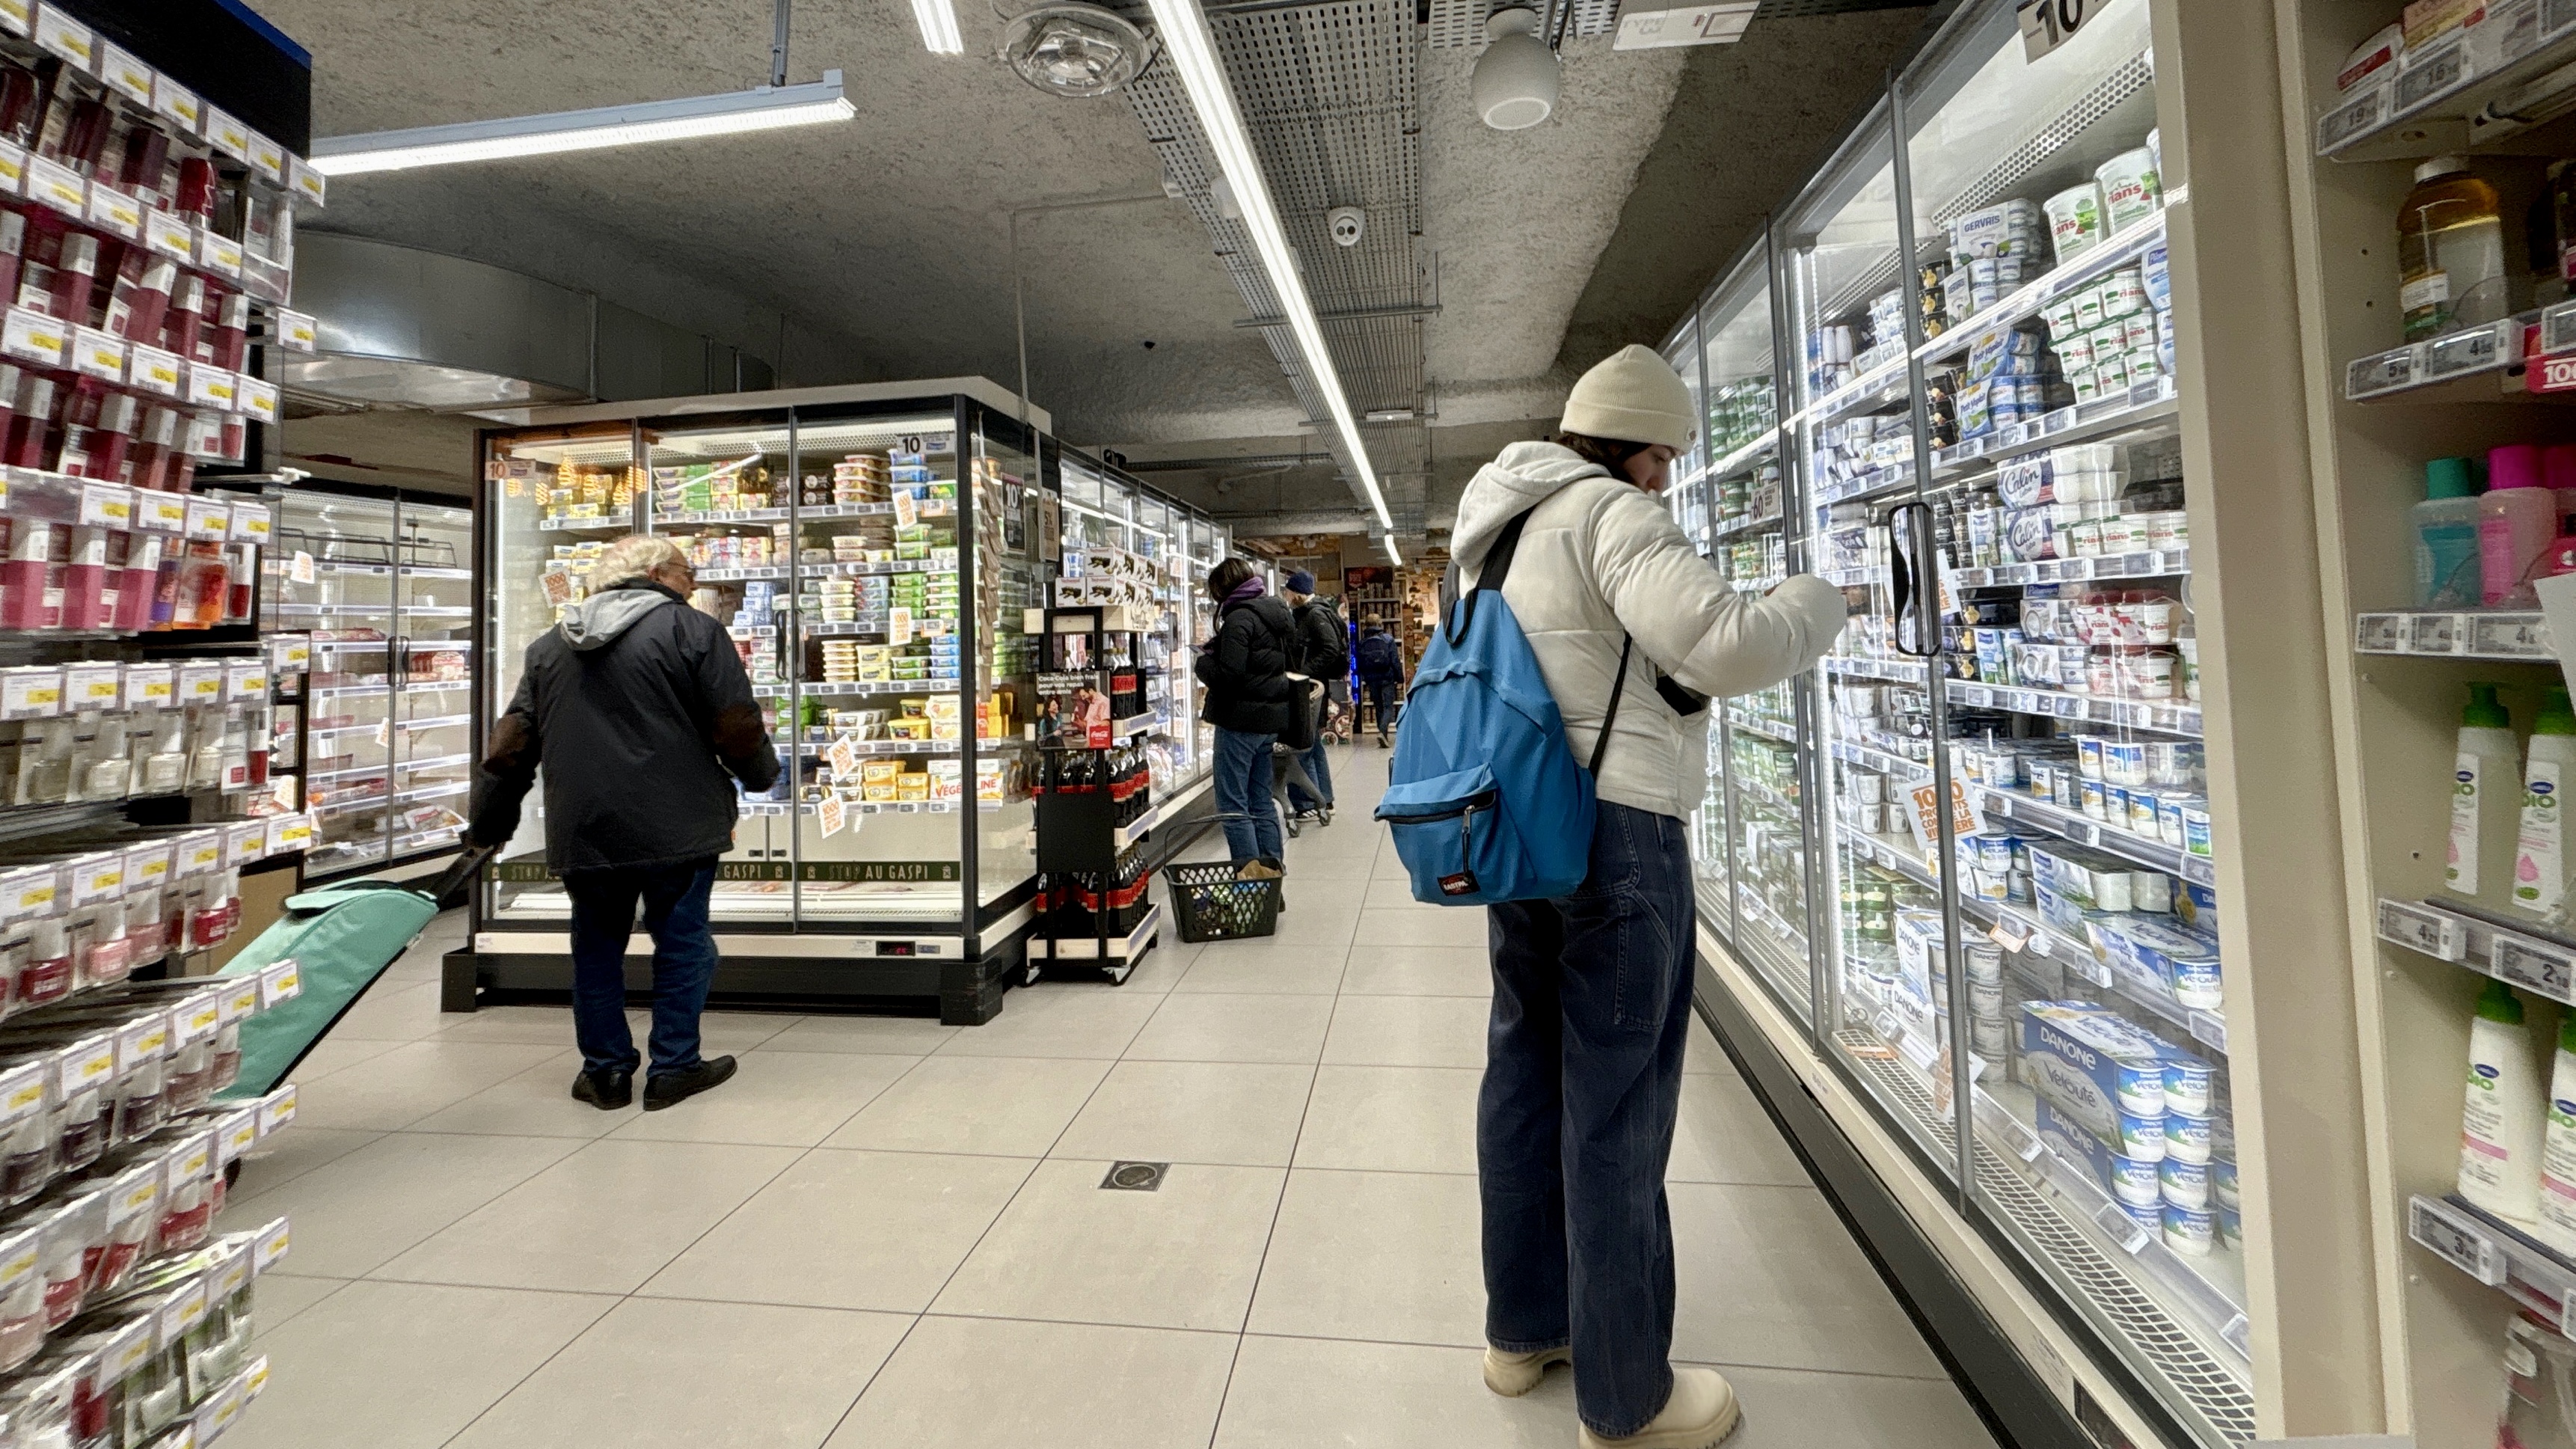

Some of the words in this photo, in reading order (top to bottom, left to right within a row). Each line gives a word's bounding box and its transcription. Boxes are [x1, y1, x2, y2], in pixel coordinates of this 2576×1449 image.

[1964, 215, 2001, 233] GERVAIS
[2005, 466, 2040, 494] Calin
[2014, 521, 2041, 547] Calin
[1913, 781, 1964, 810] 100
[723, 864, 761, 879] GASPI
[865, 865, 883, 879] AU
[889, 864, 928, 879] GASPI
[2040, 1026, 2097, 1070] DANONE
[2043, 1061, 2097, 1106] Velouté
[2049, 1106, 2094, 1153] DANONE
